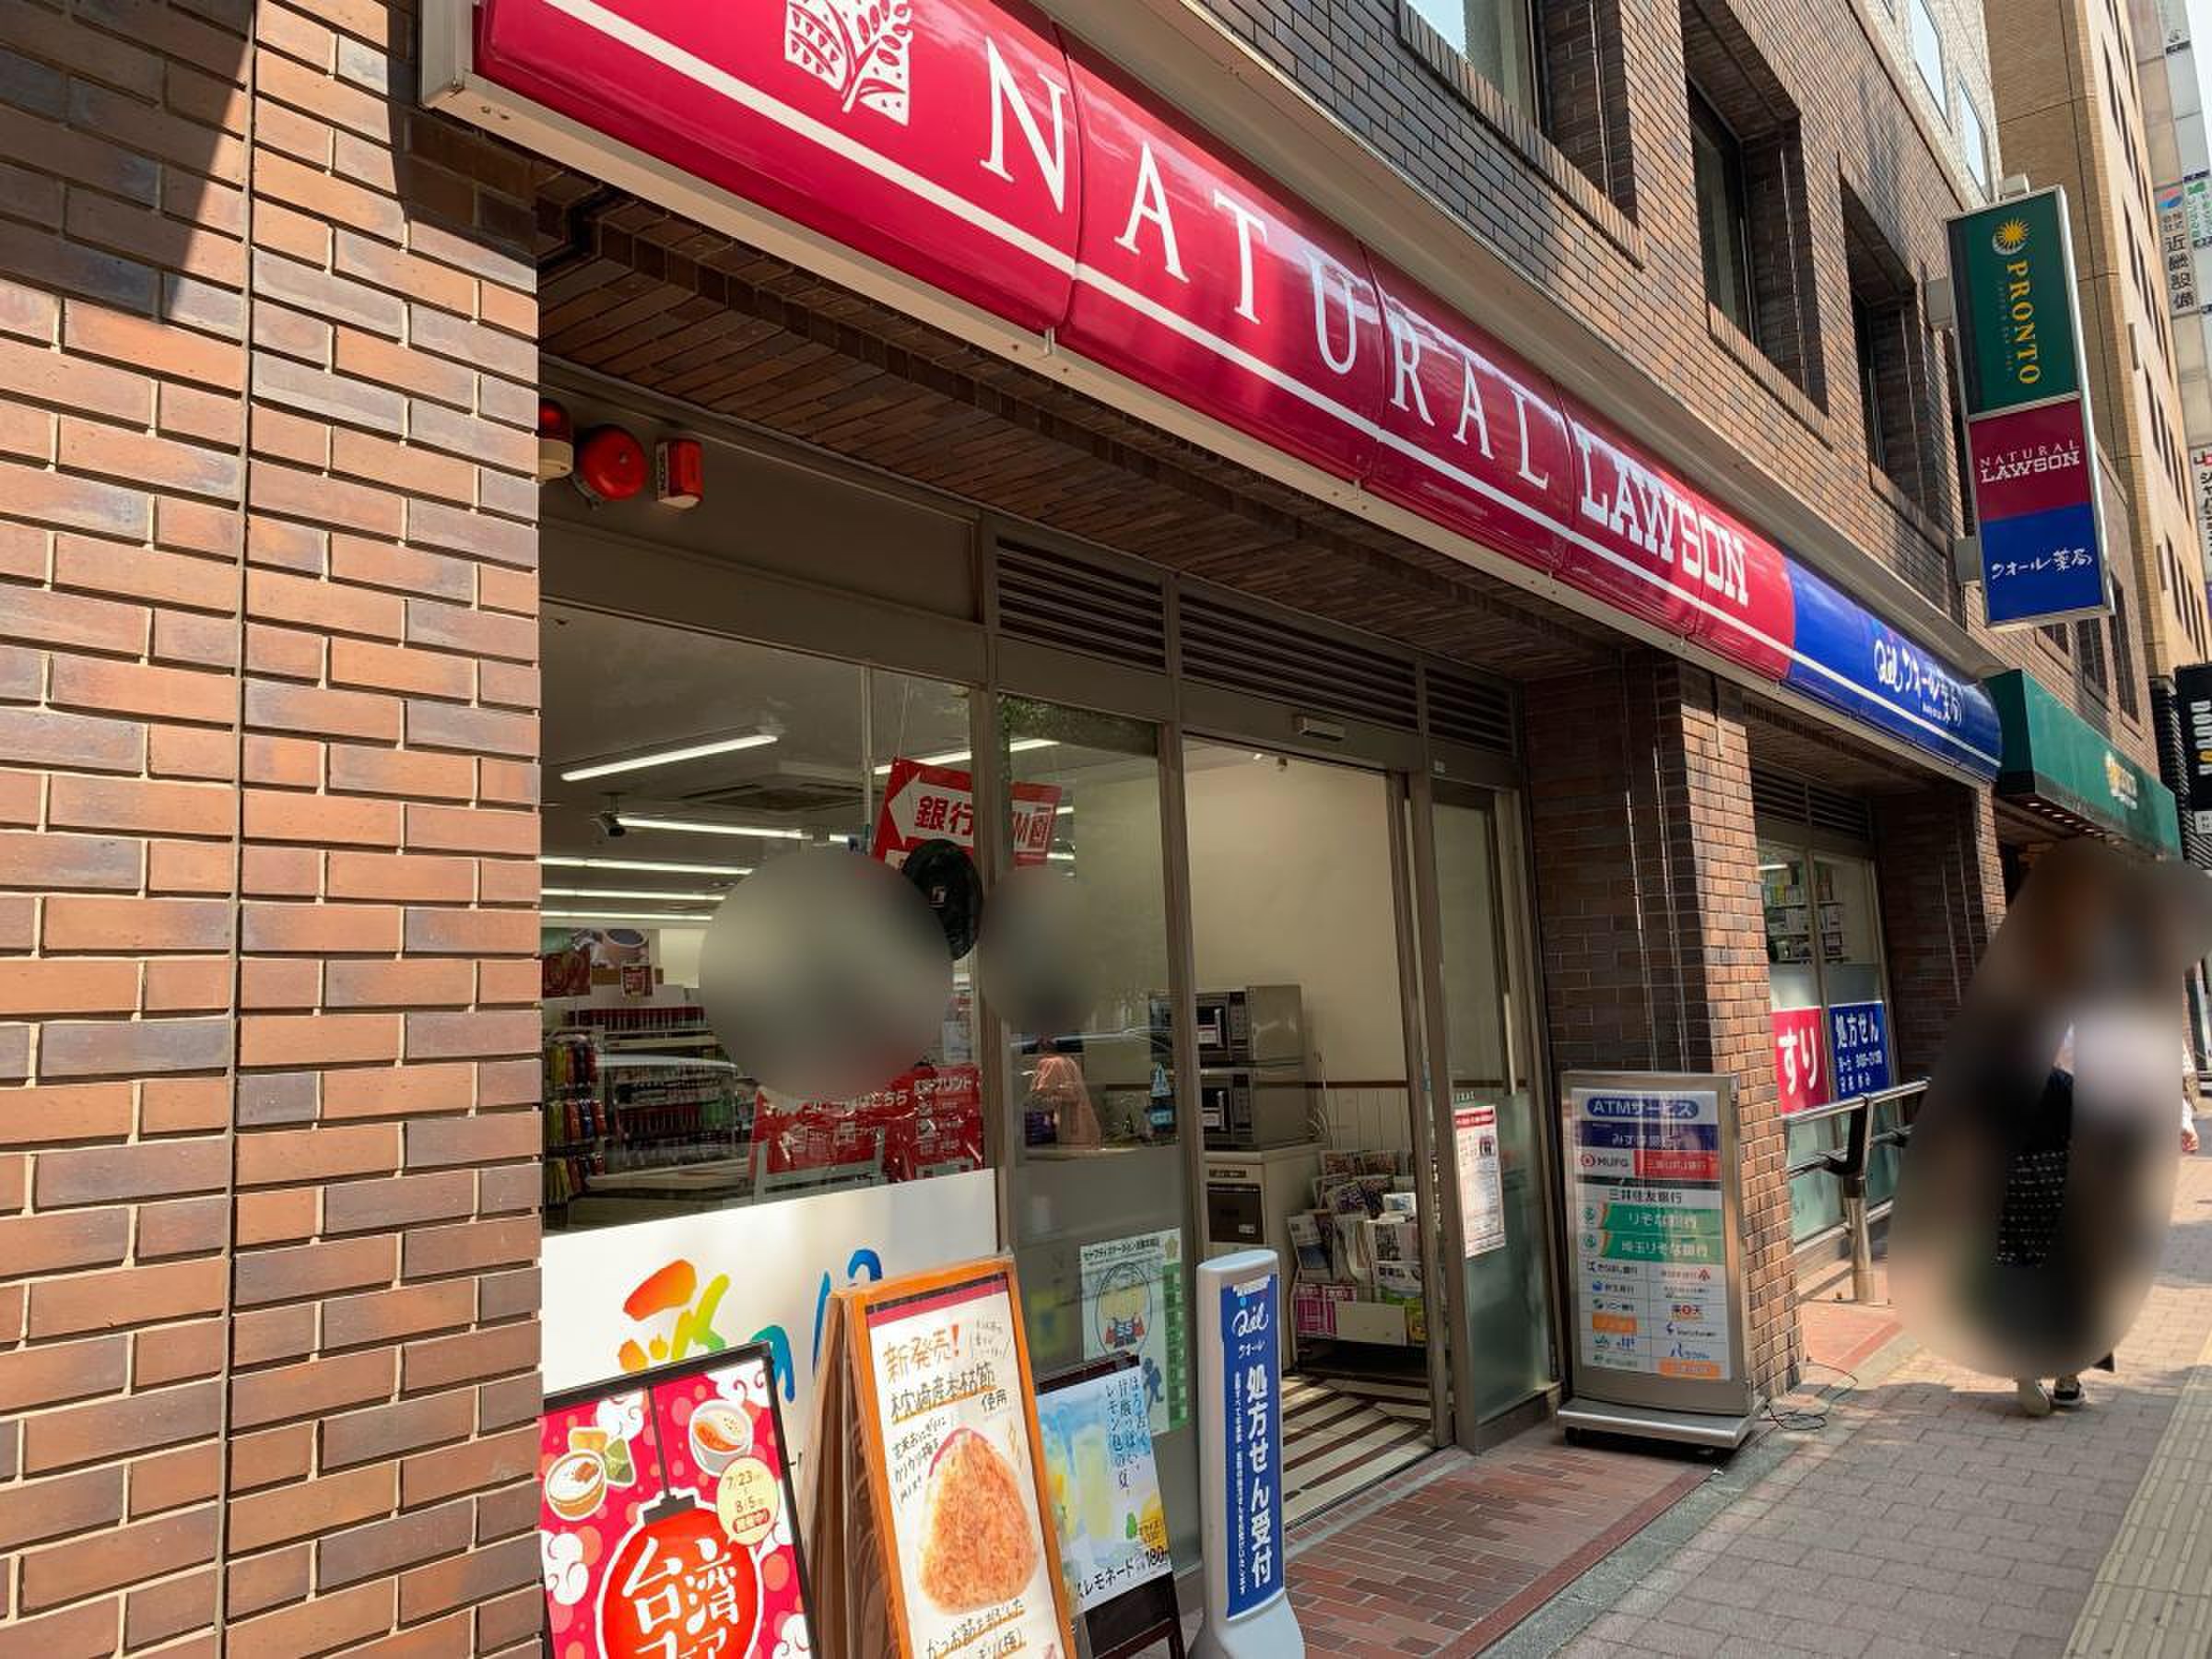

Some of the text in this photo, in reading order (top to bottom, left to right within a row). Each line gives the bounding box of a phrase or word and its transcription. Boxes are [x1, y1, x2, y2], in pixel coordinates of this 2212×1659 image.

[981, 37, 1748, 606] NATURAL LAWSON
[2006, 259, 2041, 383] PRONTO
[1980, 440, 2079, 467] NATURAL
[1981, 451, 2079, 483] LAWSON
[1991, 547, 2093, 581] クオール薬局
[1593, 1100, 1694, 1117] ATMサービス
[1246, 1363, 1272, 1588] 処方せん受付
[622, 1537, 738, 1634] 台湾
